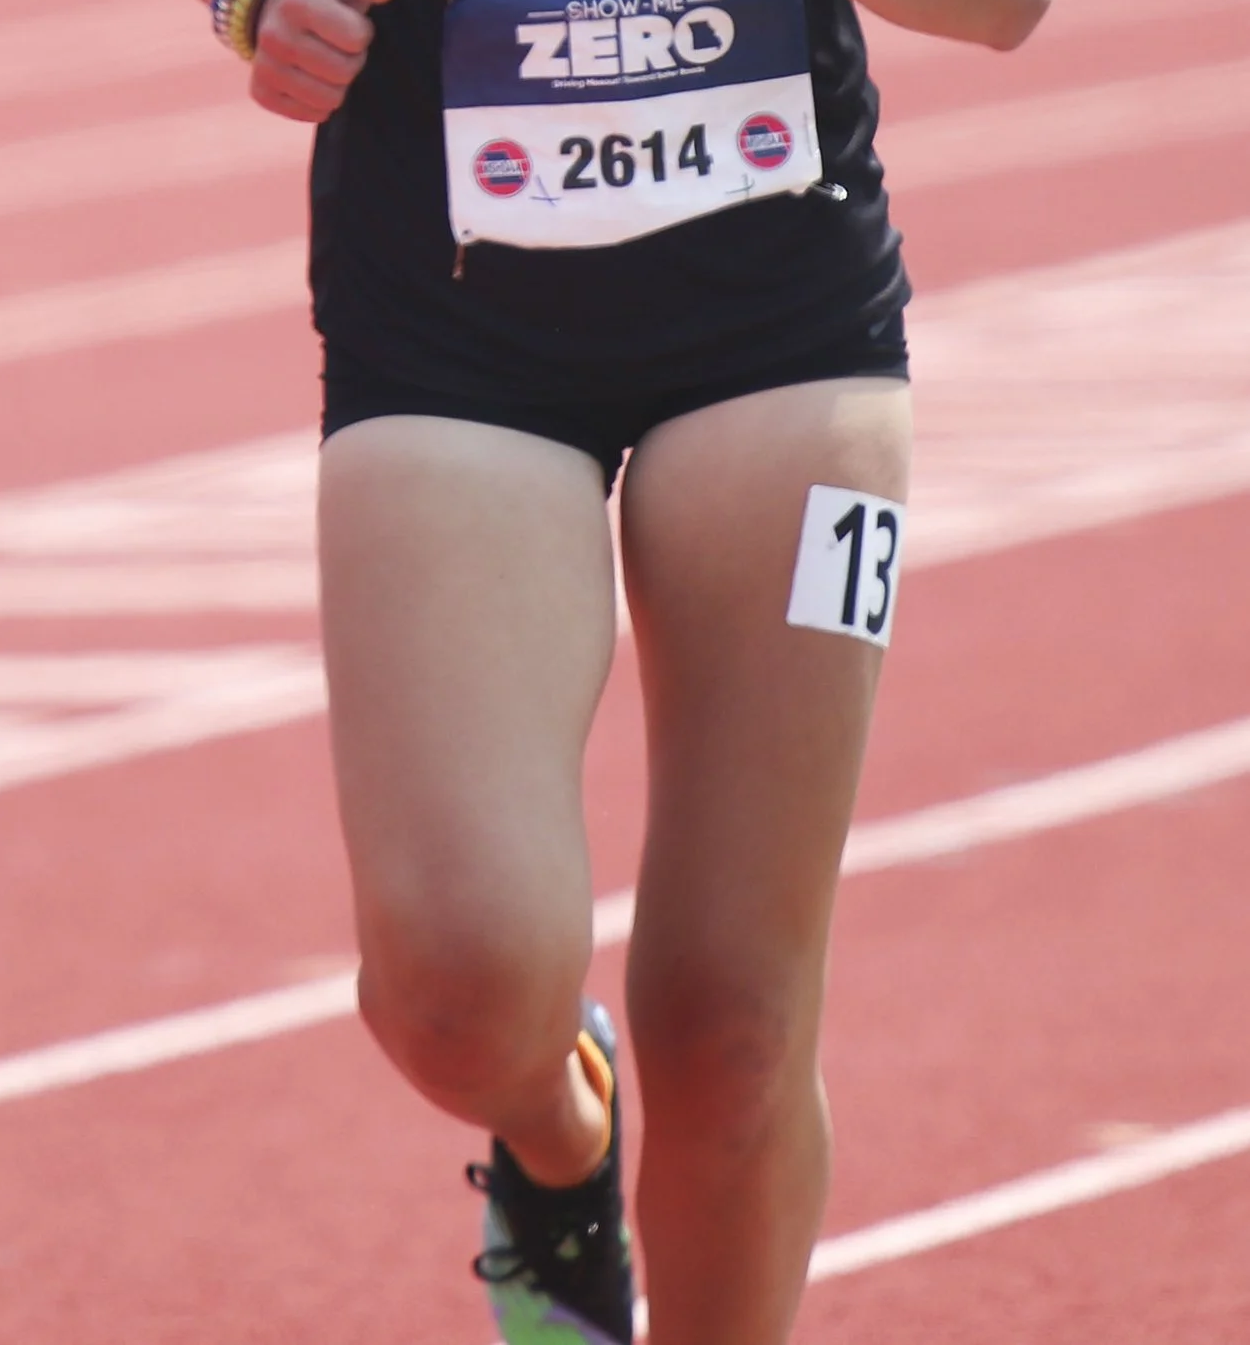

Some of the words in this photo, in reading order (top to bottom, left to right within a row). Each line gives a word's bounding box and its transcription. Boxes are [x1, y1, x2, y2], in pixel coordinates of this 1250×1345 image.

[515, 6, 735, 80] ZERO
[560, 123, 713, 190] 2614
[833, 502, 898, 636] 13
